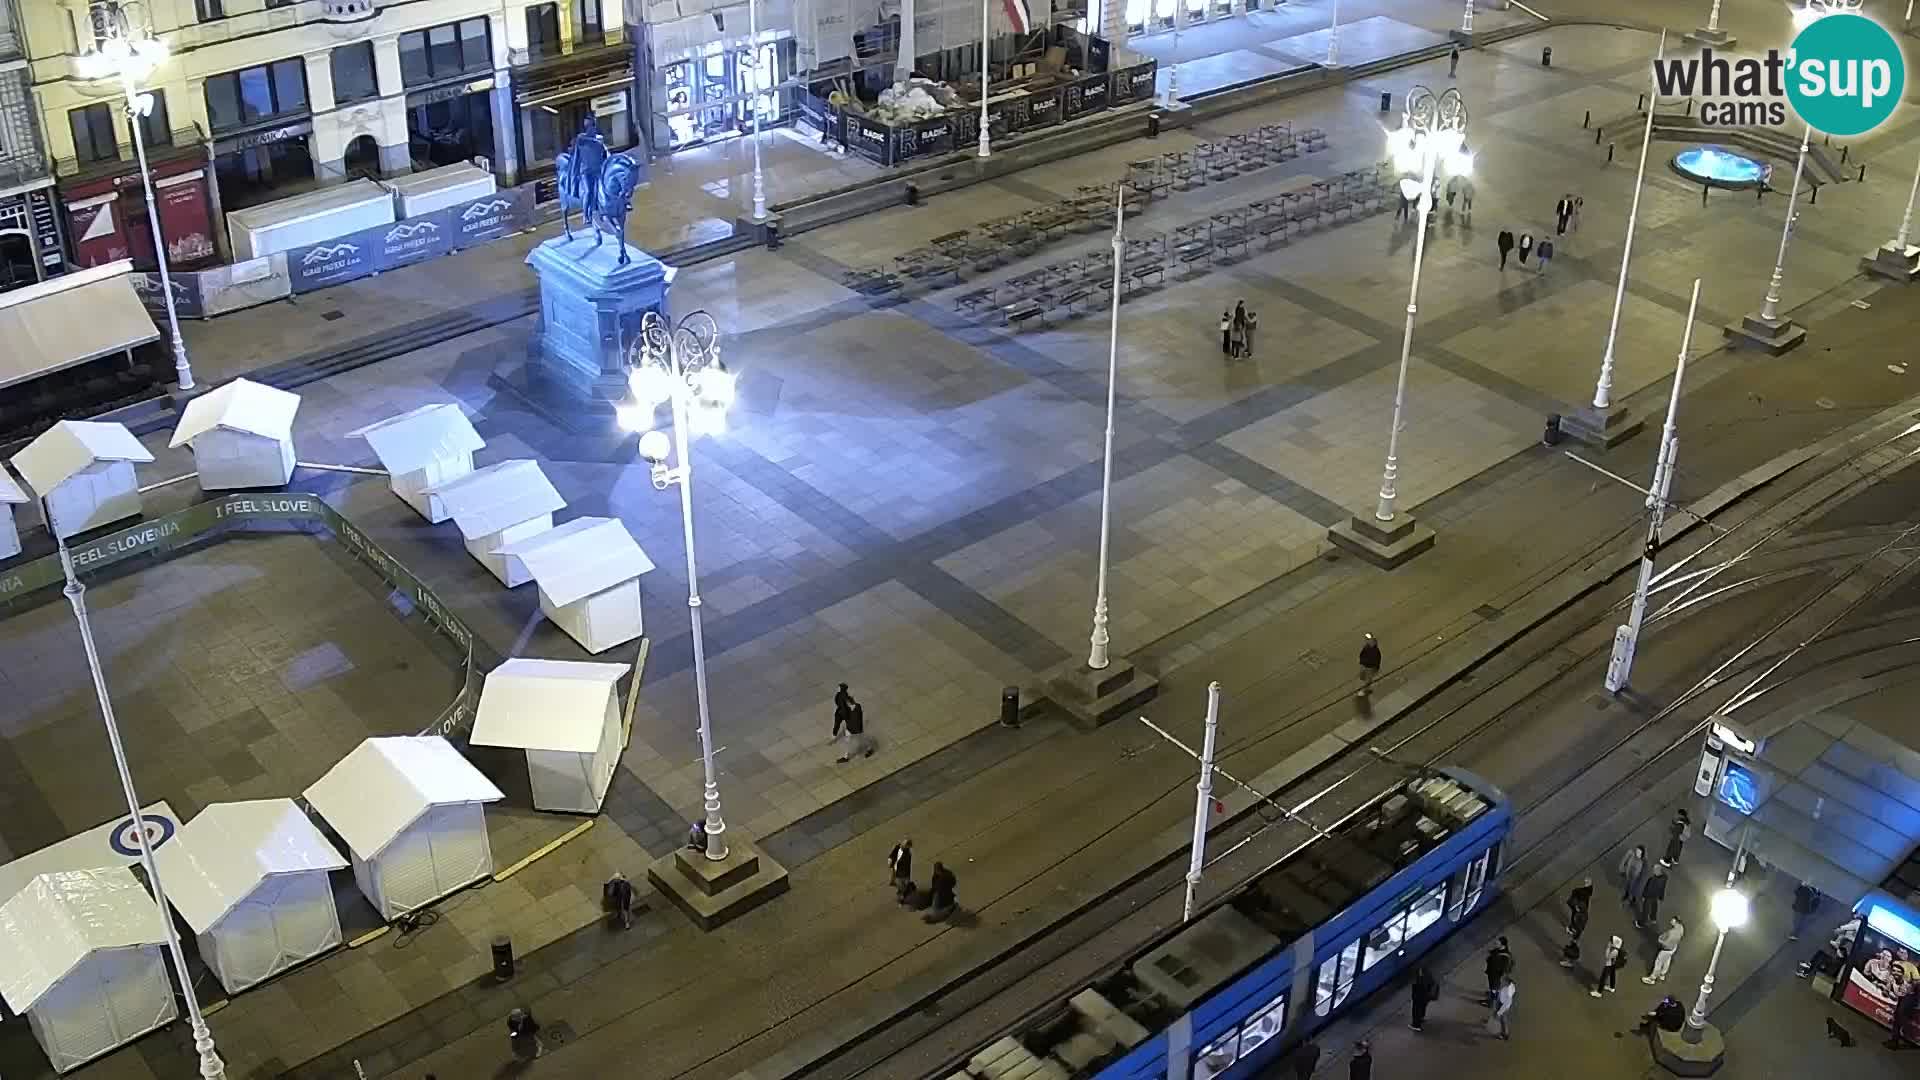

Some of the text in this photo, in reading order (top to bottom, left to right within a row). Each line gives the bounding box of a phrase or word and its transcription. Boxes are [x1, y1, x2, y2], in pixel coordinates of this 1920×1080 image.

[215, 506, 223, 518] I
[224, 500, 260, 515] FEEL
[70, 521, 181, 569] FEEL SLOVENIA
